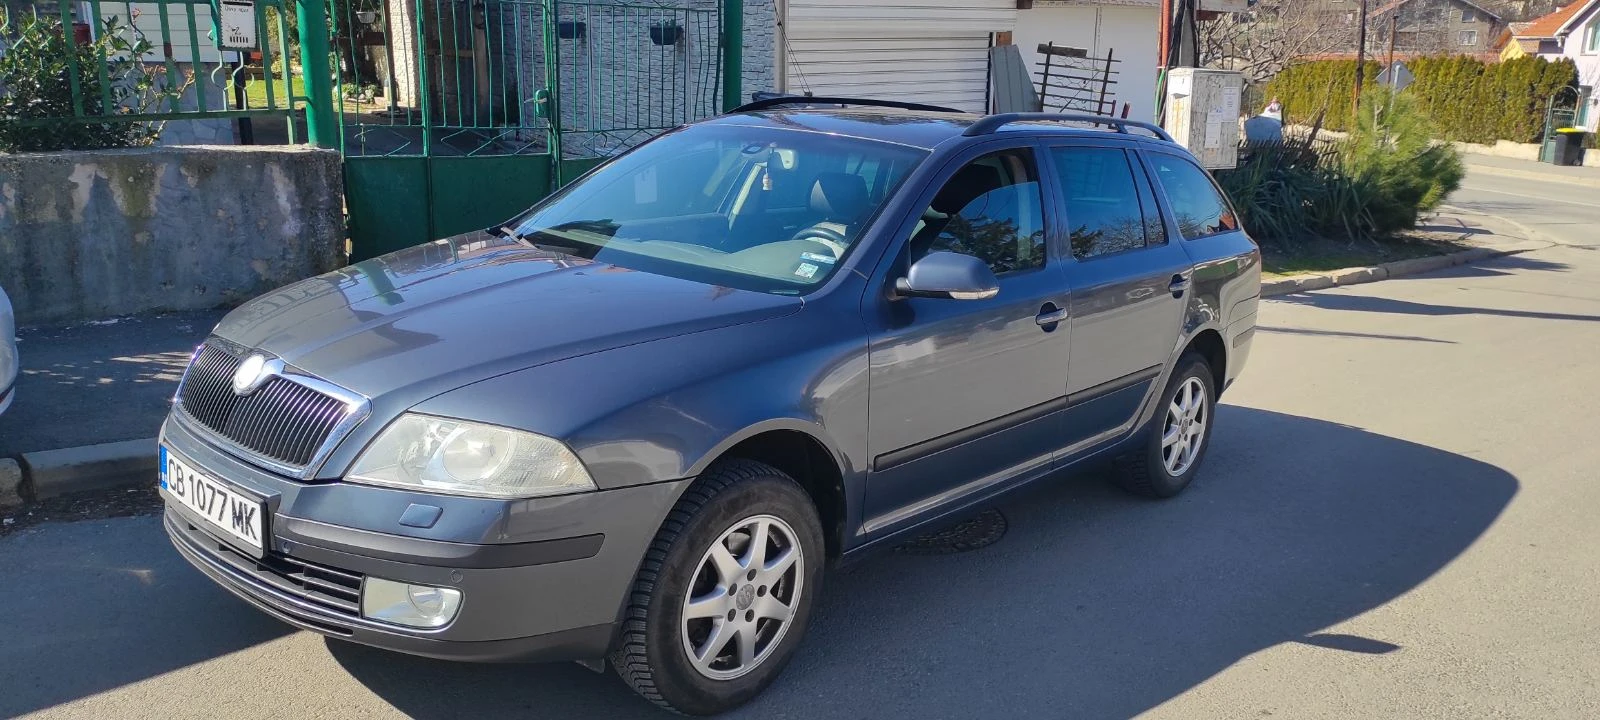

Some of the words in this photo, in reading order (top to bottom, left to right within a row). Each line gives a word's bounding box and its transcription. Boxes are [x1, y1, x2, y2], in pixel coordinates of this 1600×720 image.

[168, 458, 185, 498] CB
[188, 474, 228, 522] 1077
[231, 497, 257, 541] MK
